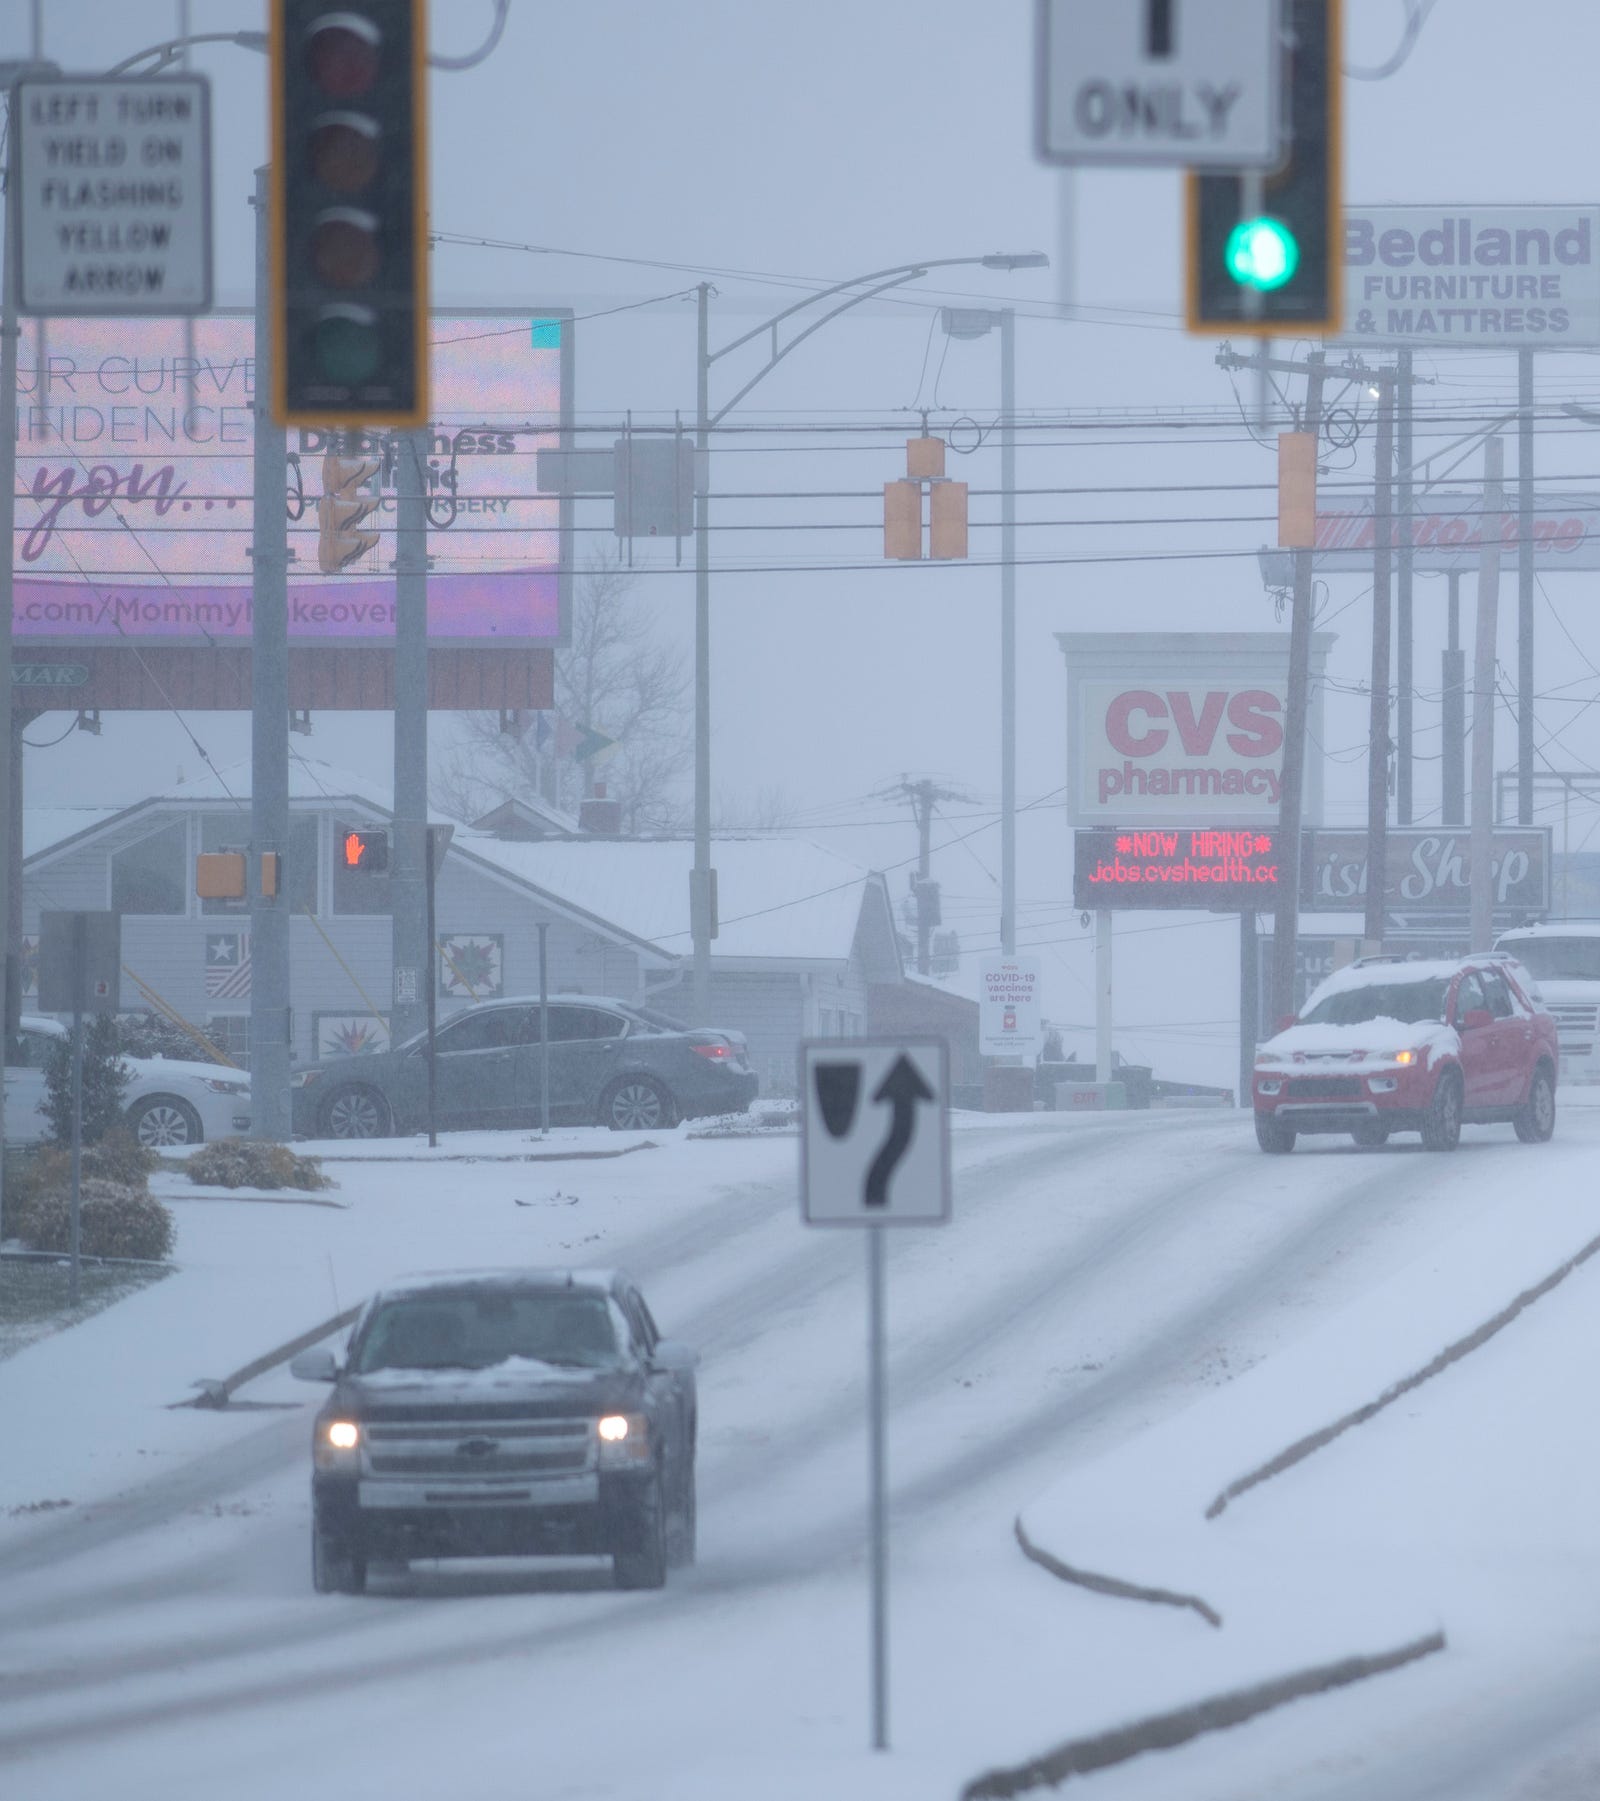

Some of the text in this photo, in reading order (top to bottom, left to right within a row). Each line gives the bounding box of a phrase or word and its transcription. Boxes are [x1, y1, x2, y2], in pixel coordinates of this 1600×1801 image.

[31, 93, 192, 125] LEFT TURN
[1074, 78, 1240, 140] ONLY
[44, 135, 182, 167] YIELD ON
[41, 177, 183, 210] FLASHING
[58, 221, 171, 251] YELLOW
[1343, 217, 1592, 266] Bedland
[64, 262, 166, 293] ARROW
[1364, 274, 1562, 300] FURNITURE
[1355, 308, 1570, 333] & MATTRESS
[16, 406, 247, 443] FIDENCE
[1105, 689, 1283, 758] CVS
[1098, 760, 1282, 804] pharmacy
[1401, 838, 1530, 902] Shp
[985, 973, 1035, 983] COVID-19
[987, 982, 1033, 993] vaccines
[989, 992, 1031, 1003] are here
